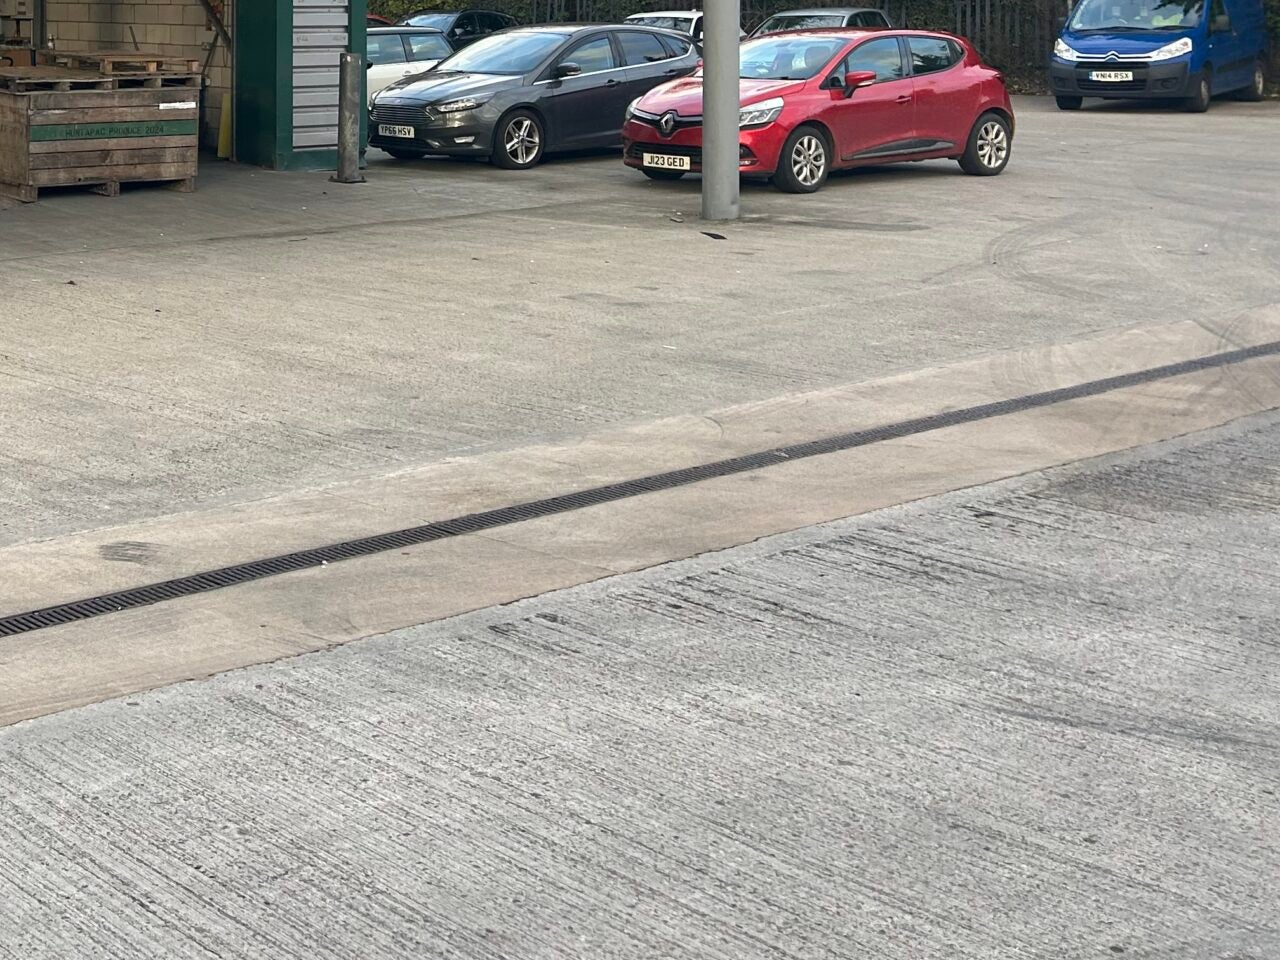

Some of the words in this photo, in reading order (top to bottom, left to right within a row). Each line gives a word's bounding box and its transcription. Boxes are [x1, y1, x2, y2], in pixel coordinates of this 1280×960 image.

[108, 126, 141, 136] PRODUCE
[380, 125, 397, 136] YP66
[647, 155, 666, 166] J123
[666, 156, 685, 168] GED
